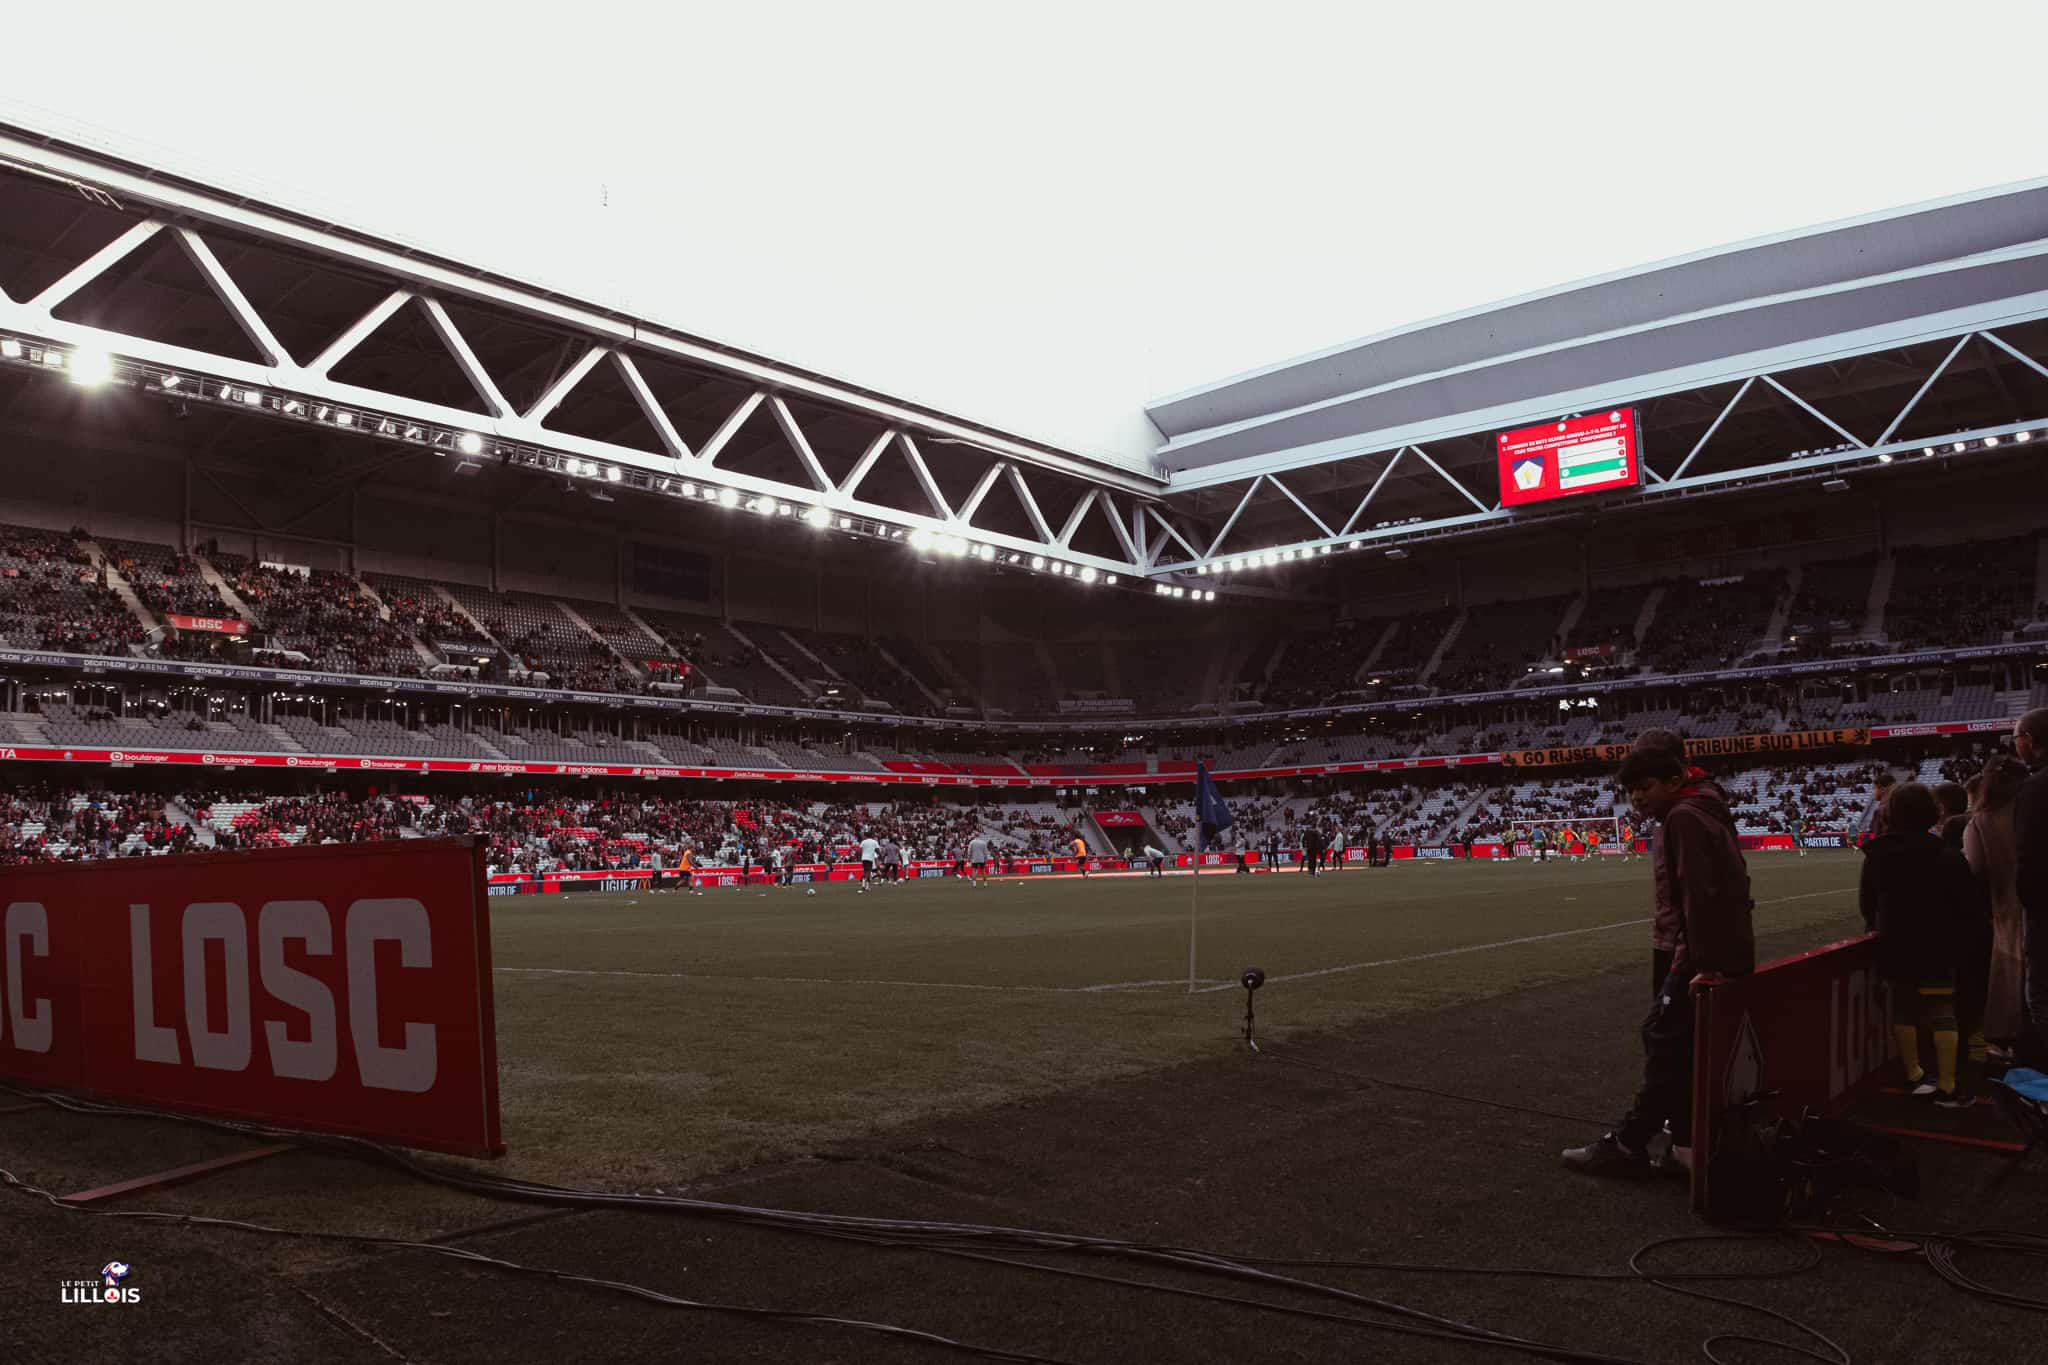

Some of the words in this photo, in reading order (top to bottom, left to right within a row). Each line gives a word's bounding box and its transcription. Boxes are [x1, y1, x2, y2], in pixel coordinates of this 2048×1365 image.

[192, 617, 223, 630] LOSC
[84, 660, 127, 669] DECATHLON
[139, 663, 169, 672] ARENA
[1686, 736, 1754, 756] TRIBUNE
[1760, 735, 1793, 751] SUD
[1797, 731, 1844, 748] LILLE
[125, 753, 168, 762] boulanger
[214, 756, 256, 765] boulanger
[1523, 751, 1544, 765] GO
[1549, 747, 1602, 764] RIJSEL
[298, 759, 337, 767] boulanger
[482, 764, 496, 772] new
[498, 763, 527, 773] balance
[583, 766, 608, 775] balance
[656, 768, 680, 777] balance
[1804, 836, 1829, 847] PARTIR
[1830, 836, 1841, 847] DE
[1205, 854, 1220, 865] LOSC
[130, 897, 437, 1093] LOSC
